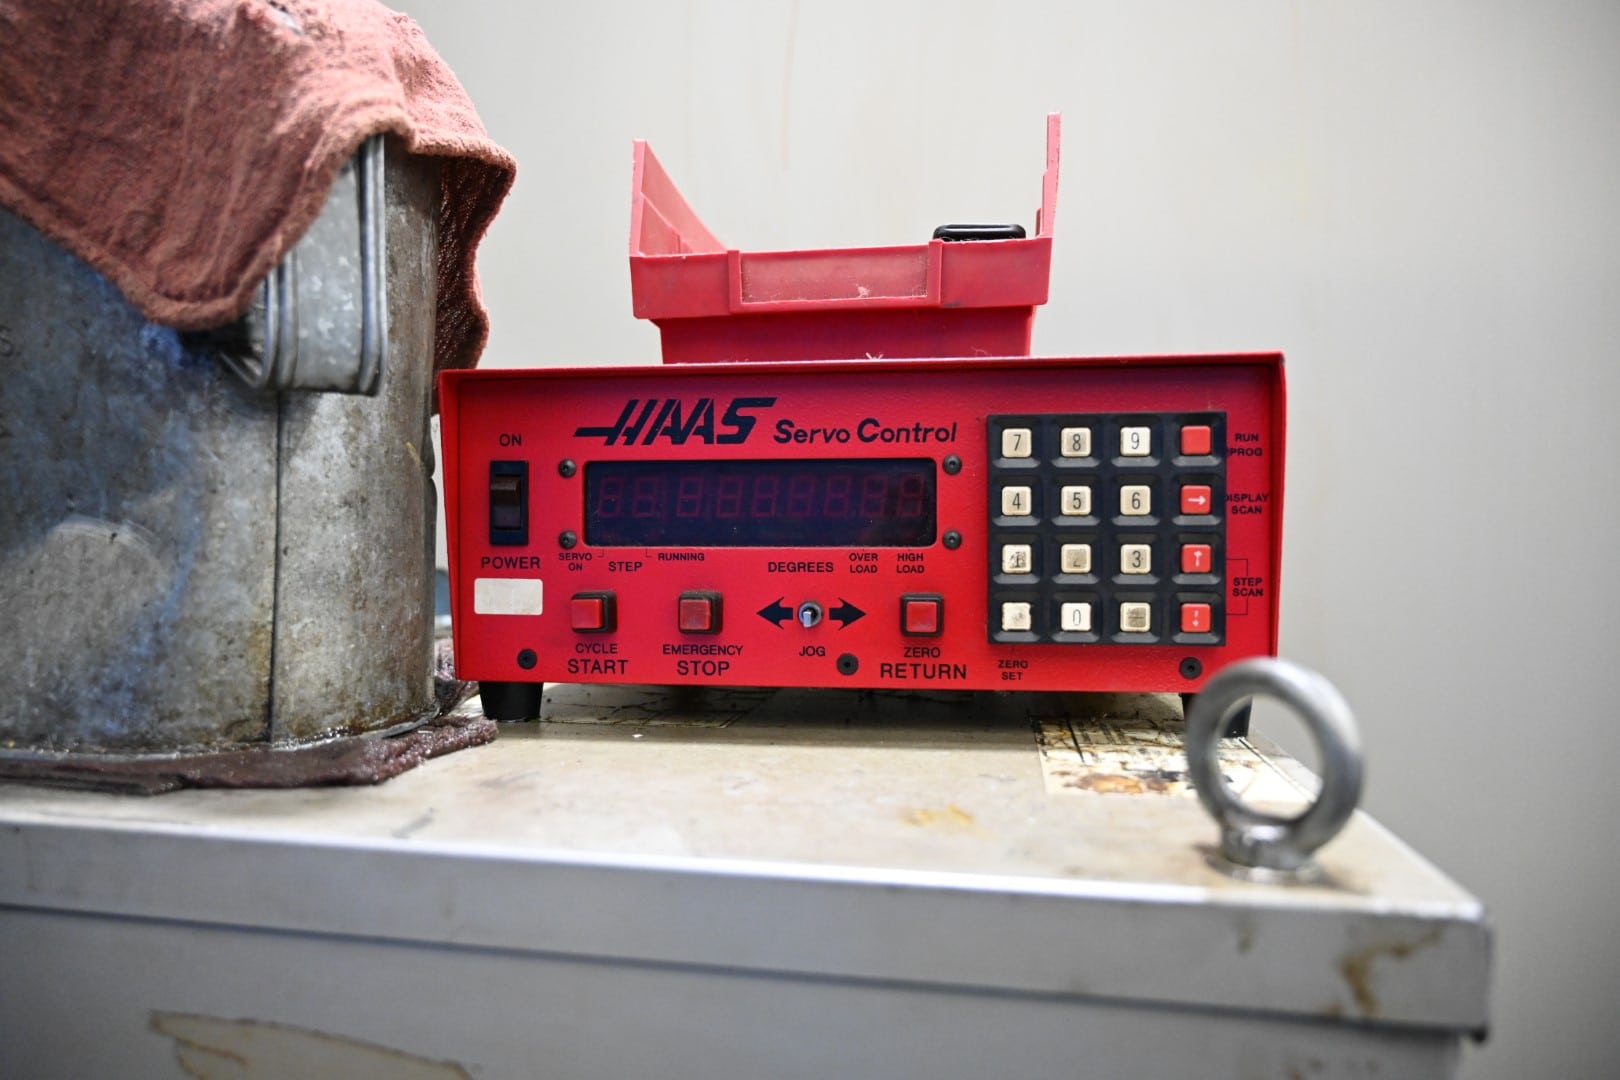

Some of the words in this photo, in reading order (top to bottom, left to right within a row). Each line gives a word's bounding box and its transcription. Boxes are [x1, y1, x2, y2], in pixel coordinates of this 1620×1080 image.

[573, 397, 777, 445] HAAS
[774, 419, 850, 443] Servo
[857, 418, 957, 442] Control
[499, 434, 522, 446] ON
[1012, 434, 1022, 451] 7
[1072, 434, 1082, 451] 8
[1131, 432, 1140, 449] 9
[1235, 432, 1259, 442] RUN
[1229, 447, 1263, 457] PROG
[1012, 492, 1022, 509] 4
[1072, 492, 1082, 509] 5
[1131, 492, 1141, 509] 6
[1231, 505, 1263, 515] SCAN
[481, 556, 541, 569] POWER
[559, 553, 592, 561] SERVO
[658, 553, 705, 561] RUNNING
[849, 553, 878, 562] OVER
[898, 553, 924, 562] HIGH
[1132, 551, 1141, 568] 3
[568, 563, 583, 572] ON
[608, 561, 643, 572] STEP
[768, 562, 834, 573] DEGREES
[850, 565, 878, 574] LOAD
[897, 565, 925, 574] LOAD
[1233, 577, 1262, 587] STEP
[1232, 587, 1264, 597] SCAN
[1072, 609, 1082, 627] 0
[576, 643, 618, 654] CYCLE
[663, 645, 743, 656] EMERGENCY
[799, 646, 826, 657] JOG
[904, 647, 941, 658] ZERO
[568, 659, 628, 675] START
[677, 661, 730, 676] STOP
[998, 660, 1028, 669] ZERO
[880, 663, 967, 680] RETURN
[1002, 671, 1023, 680] SET
